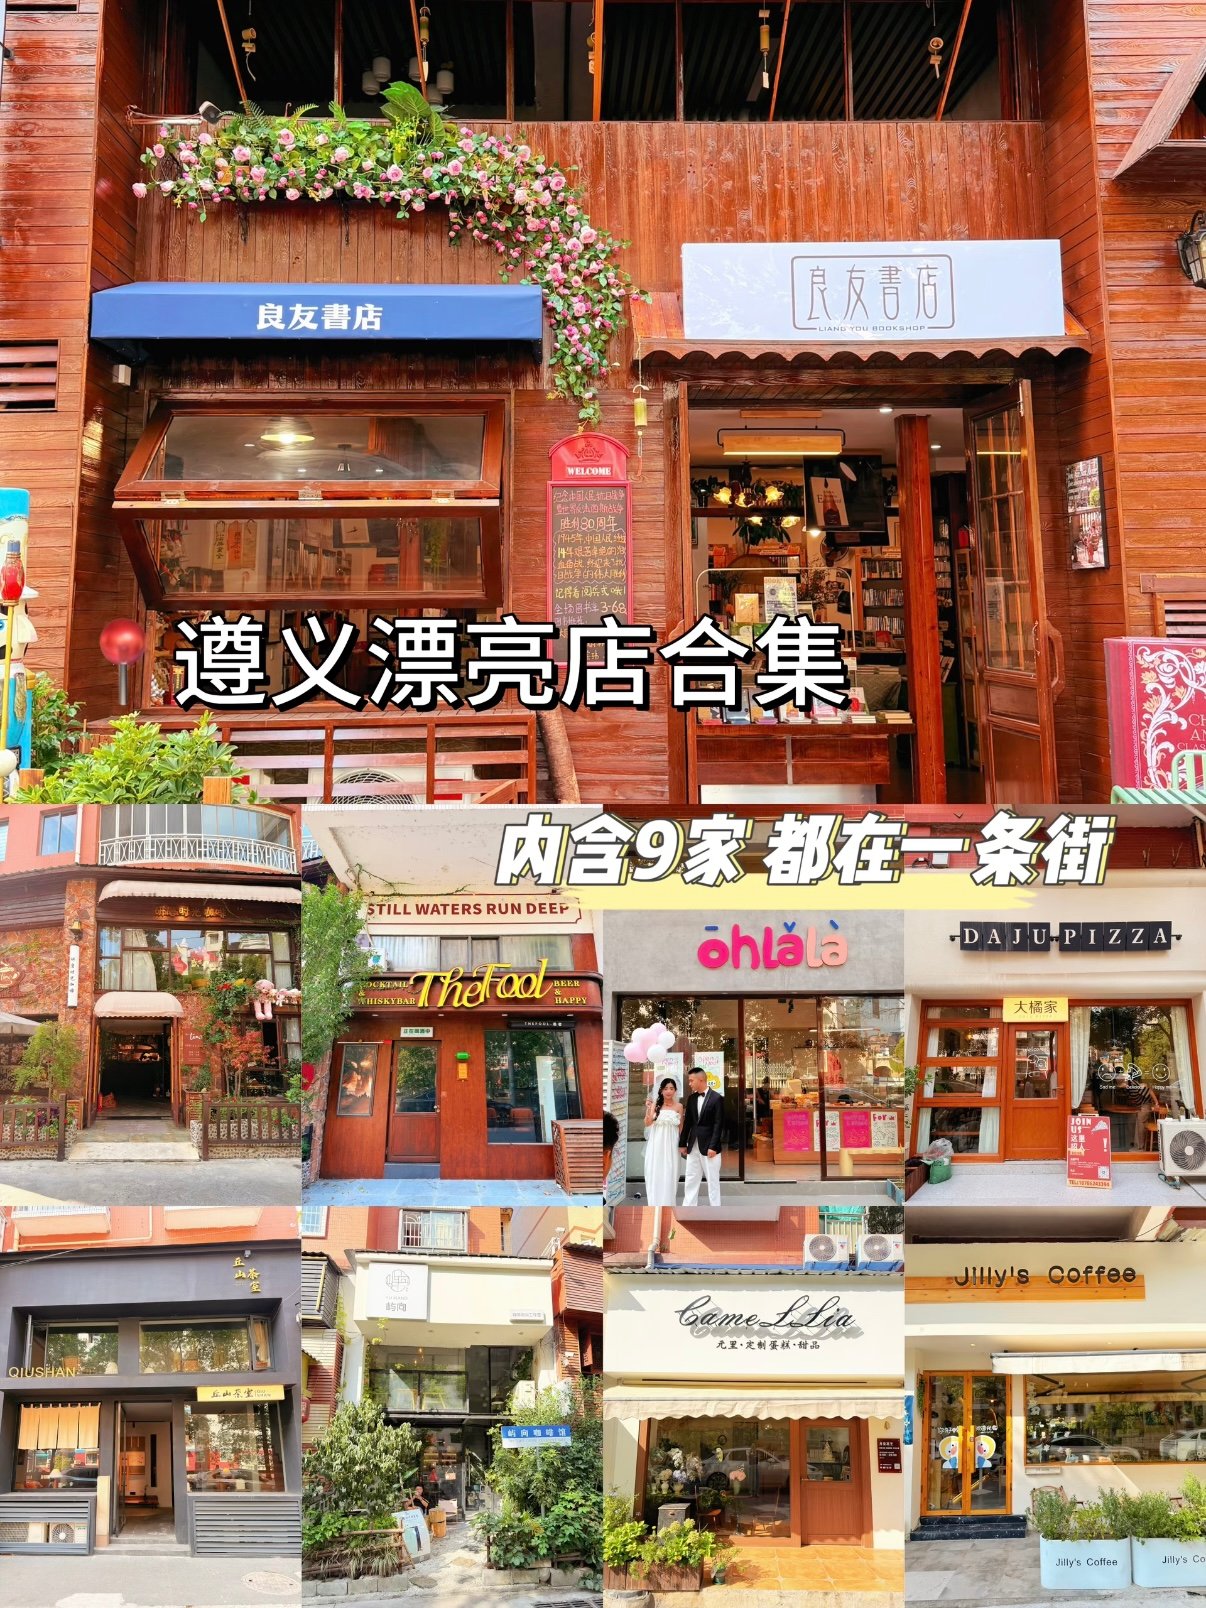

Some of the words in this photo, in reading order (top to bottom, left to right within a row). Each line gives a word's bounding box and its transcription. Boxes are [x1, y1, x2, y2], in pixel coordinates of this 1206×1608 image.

[808, 263, 938, 321] 良友書店
[256, 303, 384, 330] 良友書店
[566, 466, 612, 476] WELCOME
[560, 515, 618, 532] 胜利80周年
[367, 903, 411, 915] STILL
[415, 903, 482, 915] WATERS
[486, 903, 521, 915] RUN
[526, 902, 569, 914] DEEP
[963, 928, 1047, 945] DAJU
[1064, 928, 1168, 945] PIZZA
[1014, 1000, 1058, 1014] 大橘家
[1071, 1118, 1091, 1126] JOIN
[1071, 1126, 1082, 1134] US
[955, 1266, 1029, 1287] Jilly's
[1049, 1265, 1136, 1284] Coffee
[8, 1366, 76, 1378] QIUSHAN
[1055, 1558, 1082, 1568] Jilly's
[1086, 1558, 1118, 1567] Coffee
[1162, 1555, 1188, 1565] Jilly's
